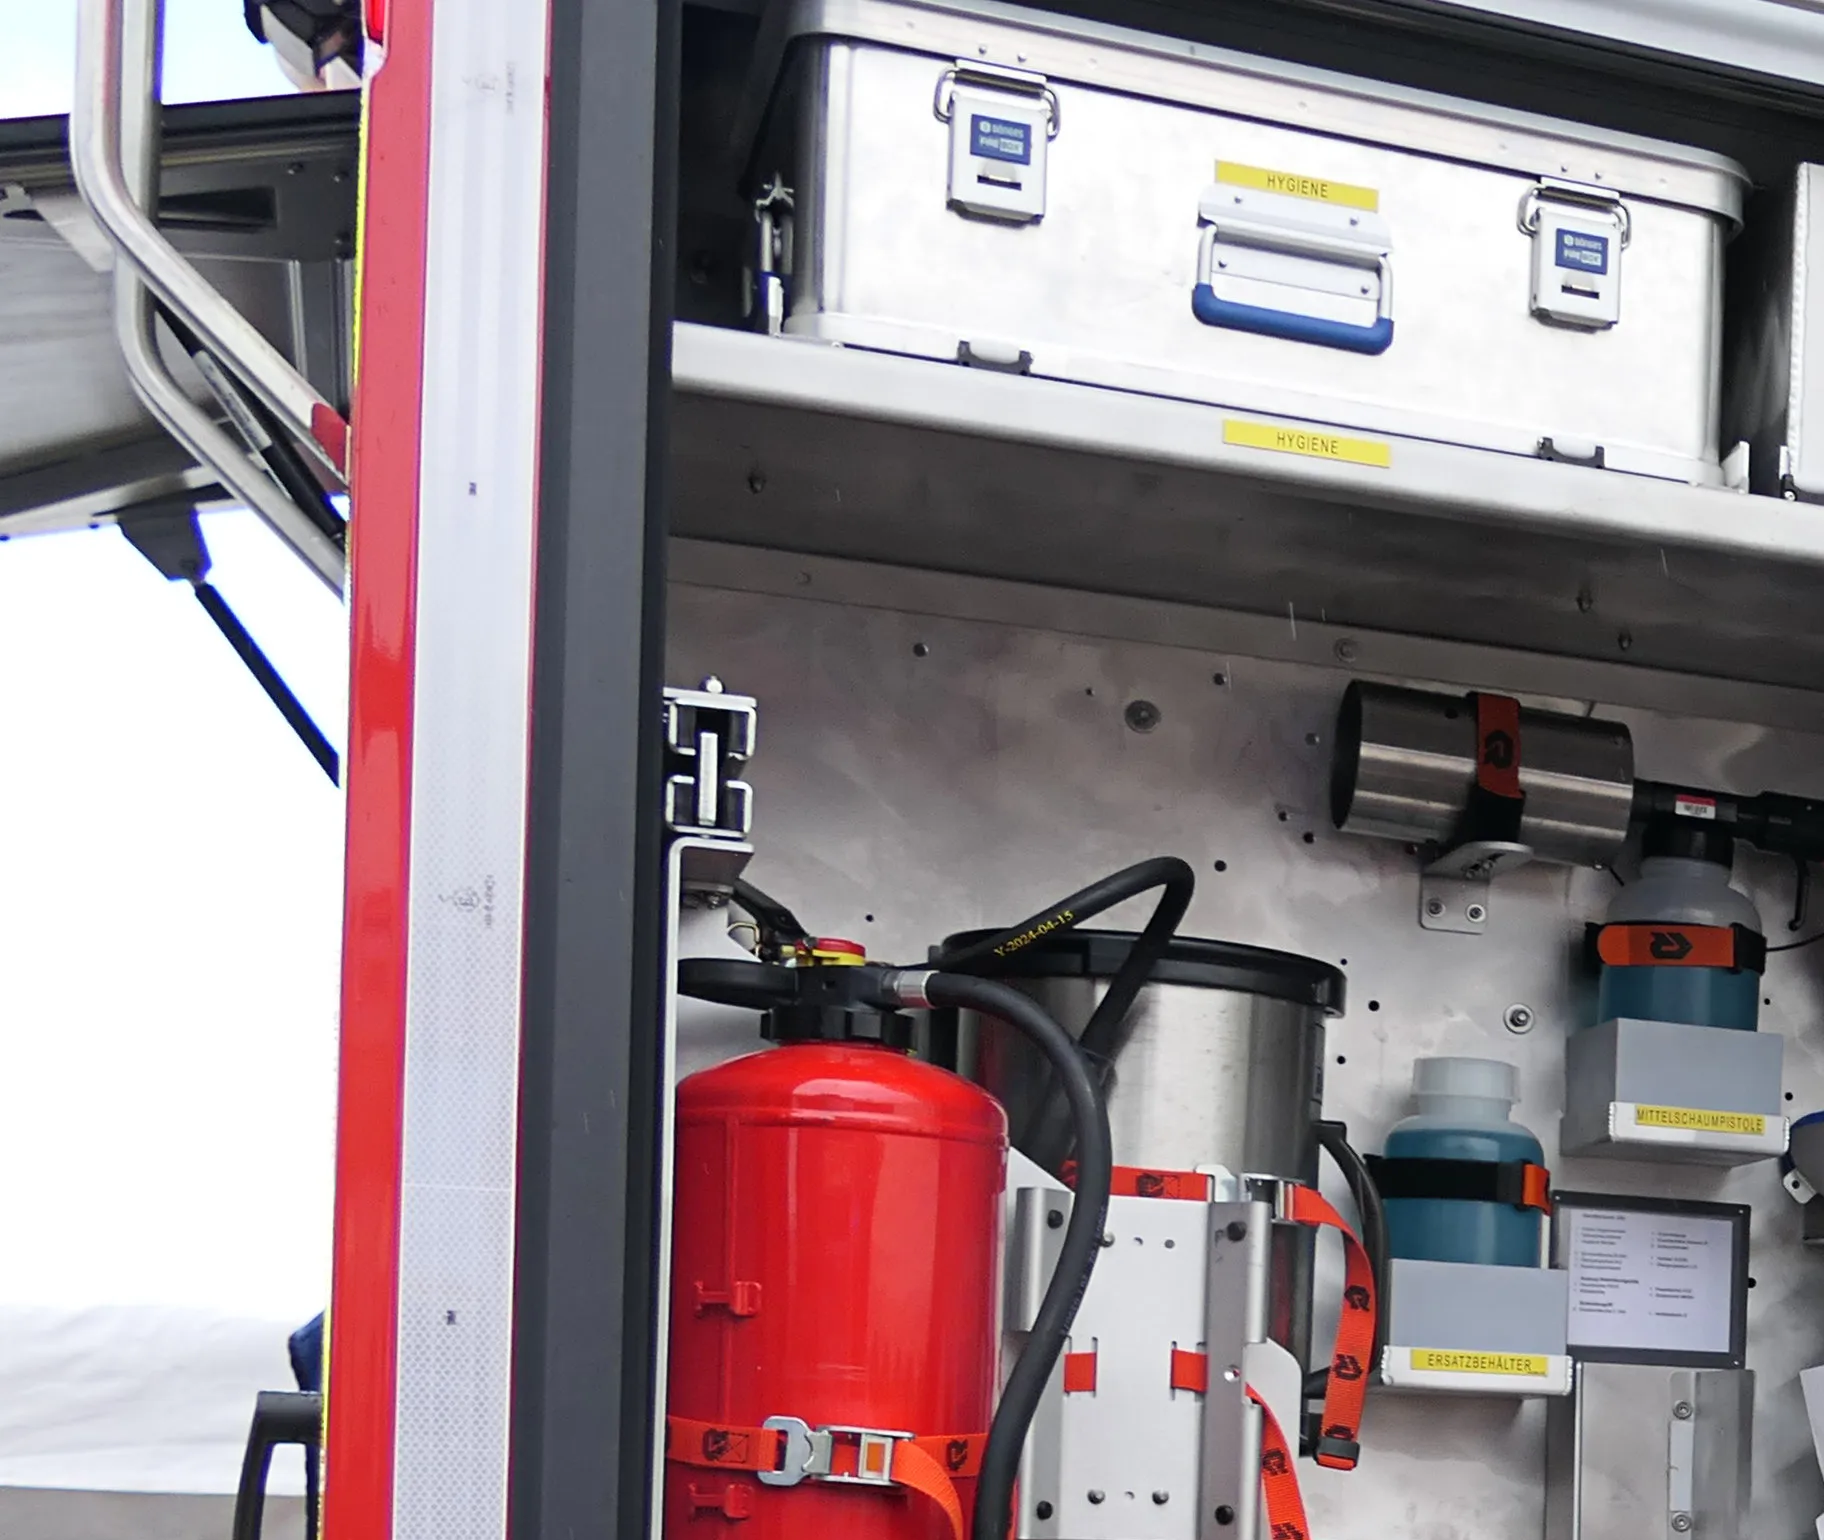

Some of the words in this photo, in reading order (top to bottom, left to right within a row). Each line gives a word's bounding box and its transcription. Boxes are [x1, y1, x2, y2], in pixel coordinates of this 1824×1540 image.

[1267, 174, 1329, 198] HYGIENE
[1276, 431, 1339, 454] HYGIENE
[1637, 1108, 1763, 1132] MITTELSCHAUMPISTOLE
